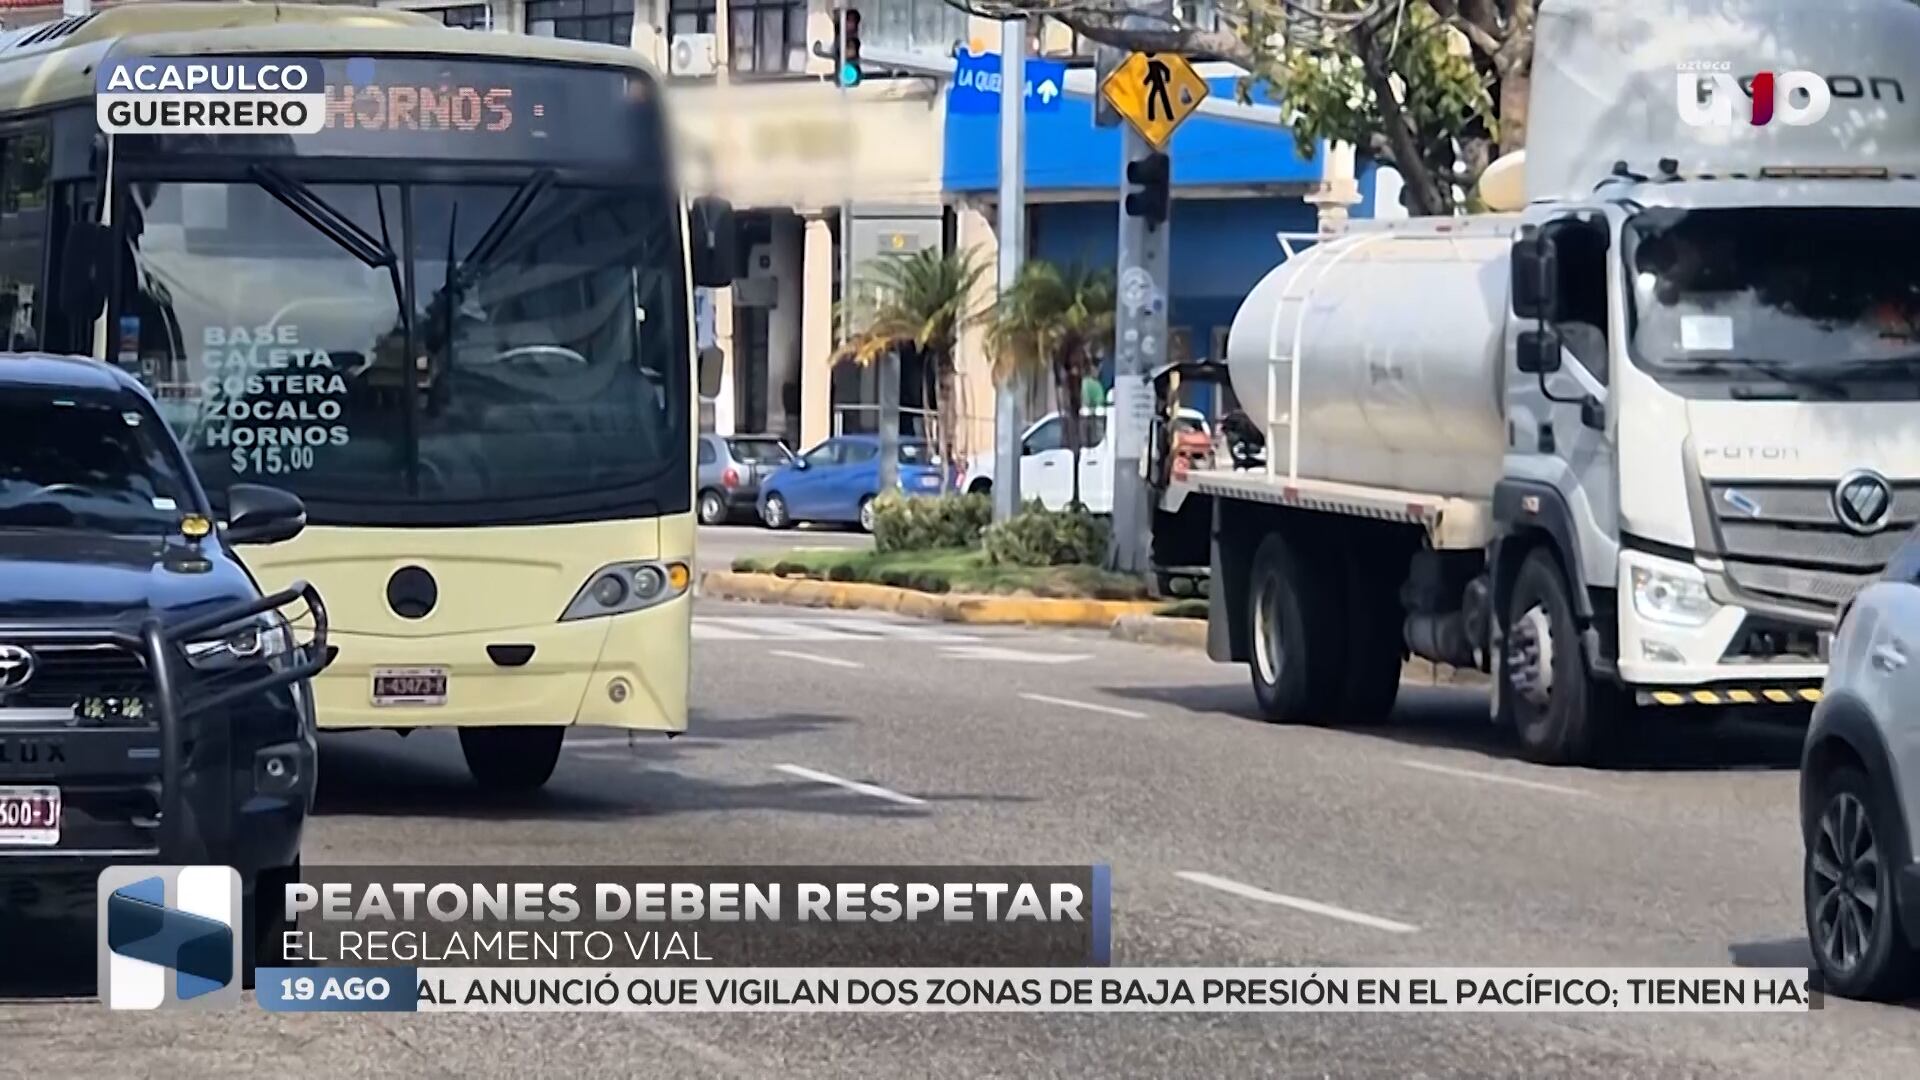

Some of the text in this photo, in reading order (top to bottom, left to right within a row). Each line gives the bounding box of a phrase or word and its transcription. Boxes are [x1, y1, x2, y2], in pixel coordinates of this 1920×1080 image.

[326, 85, 512, 131] HORNOS
[203, 325, 299, 346] BASE
[202, 349, 333, 369] CALETA
[202, 374, 347, 396] COSTERA
[206, 400, 341, 420] ZOCALO
[206, 425, 349, 447] HORNOS
[231, 446, 314, 474] $15.00
